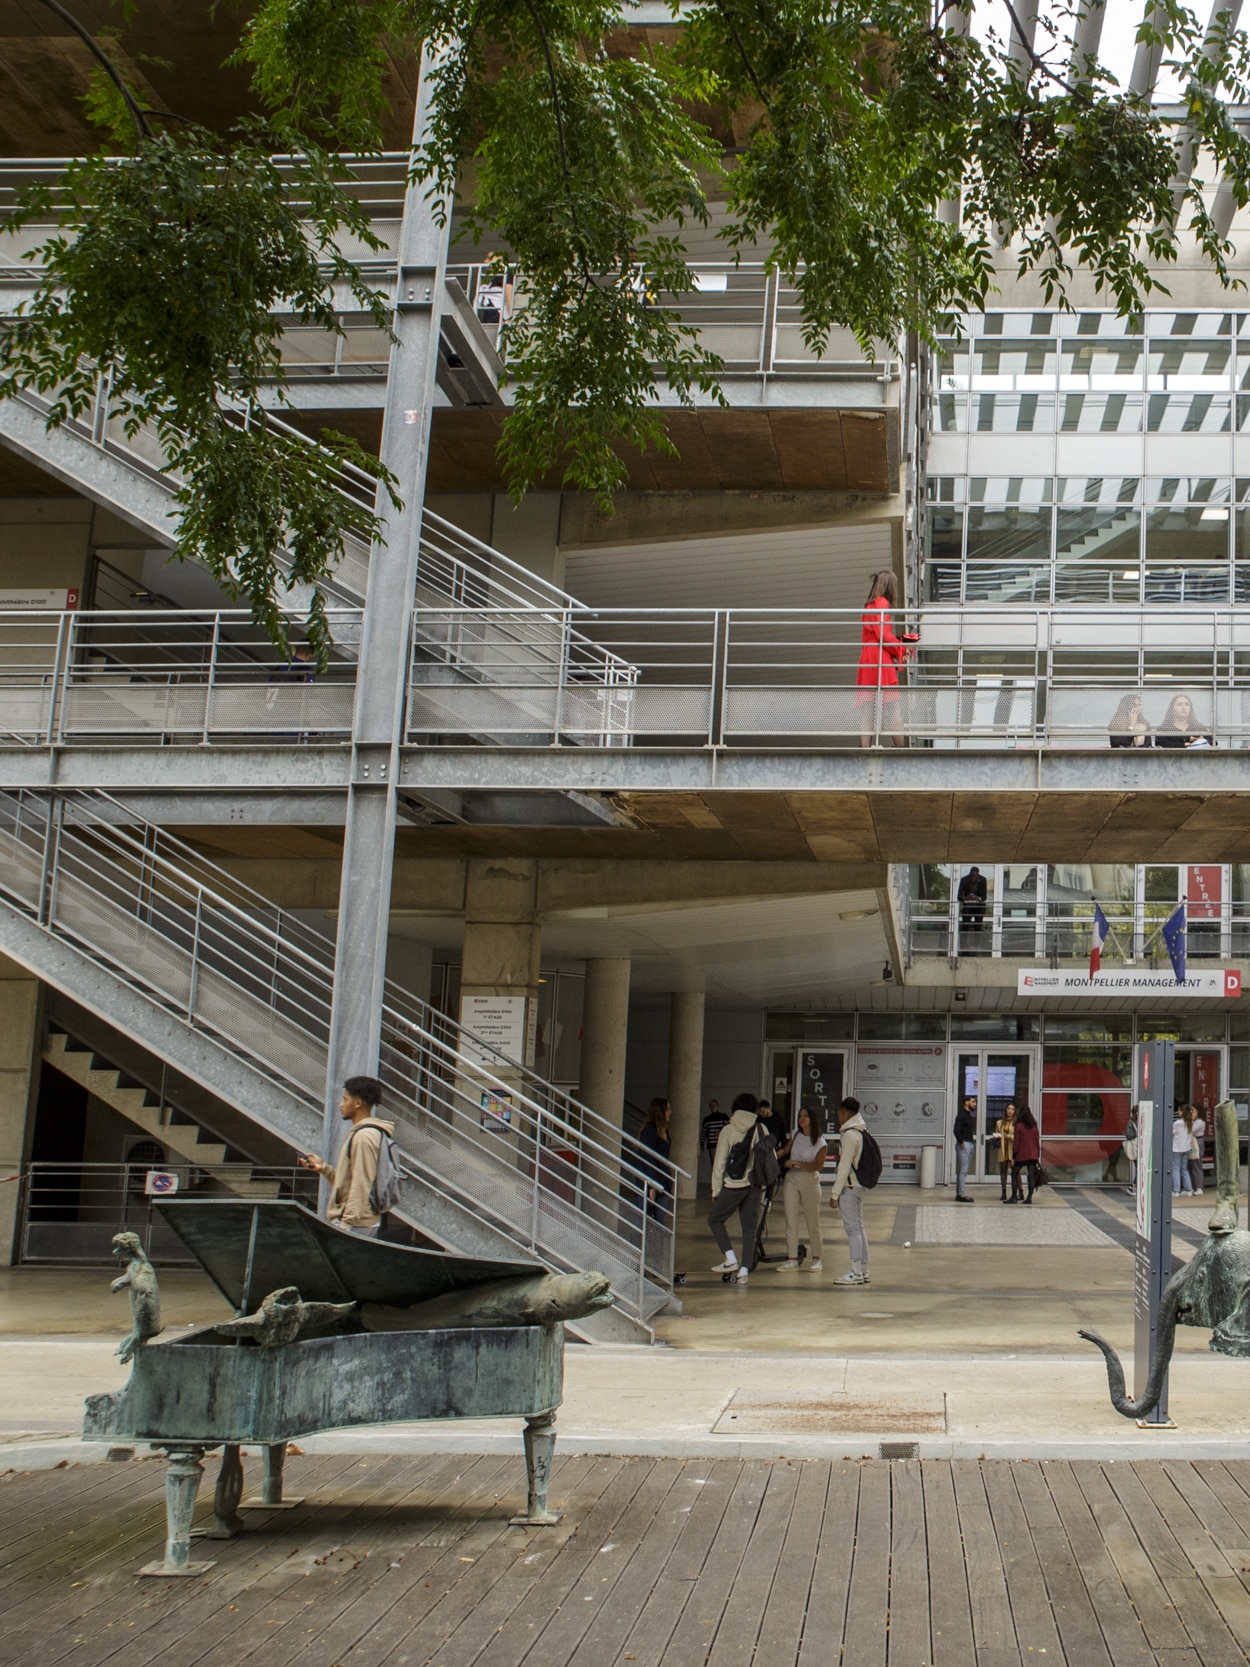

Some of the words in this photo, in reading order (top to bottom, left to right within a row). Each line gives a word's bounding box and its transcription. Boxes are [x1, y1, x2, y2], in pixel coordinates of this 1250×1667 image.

[68, 594, 77, 603] D
[1064, 978, 1130, 987] MONTPELLIER
[1227, 976, 1239, 990] D
[807, 1055, 835, 1133] SORTIE
[1197, 1056, 1214, 1136] ENTRÉE
